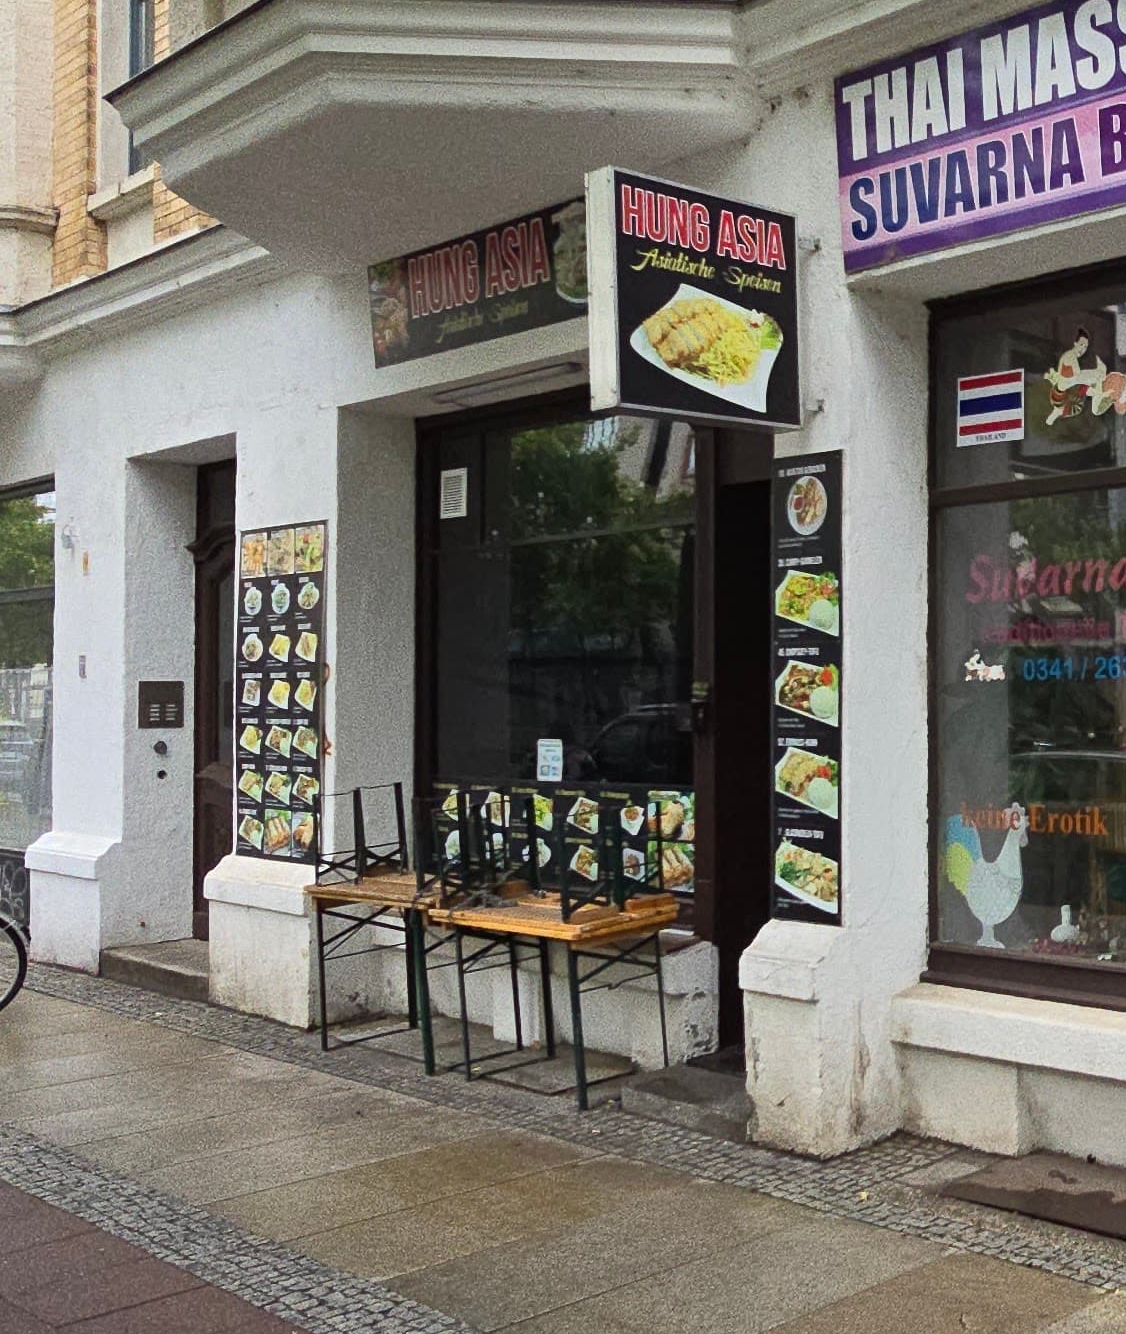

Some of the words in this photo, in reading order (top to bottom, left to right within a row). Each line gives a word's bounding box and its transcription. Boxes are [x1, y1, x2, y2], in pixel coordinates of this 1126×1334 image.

[841, 48, 966, 161] THAI
[849, 119, 1085, 241] SUVARNA
[407, 239, 480, 319] HUNG
[484, 217, 551, 298] ASIA
[621, 183, 710, 253] HUNG
[716, 208, 787, 271] ASIA
[631, 248, 716, 280] Asiatische
[722, 266, 782, 294] Speisen
[1023, 656, 1074, 681] 0341
[1028, 803, 1108, 836] Erotik
